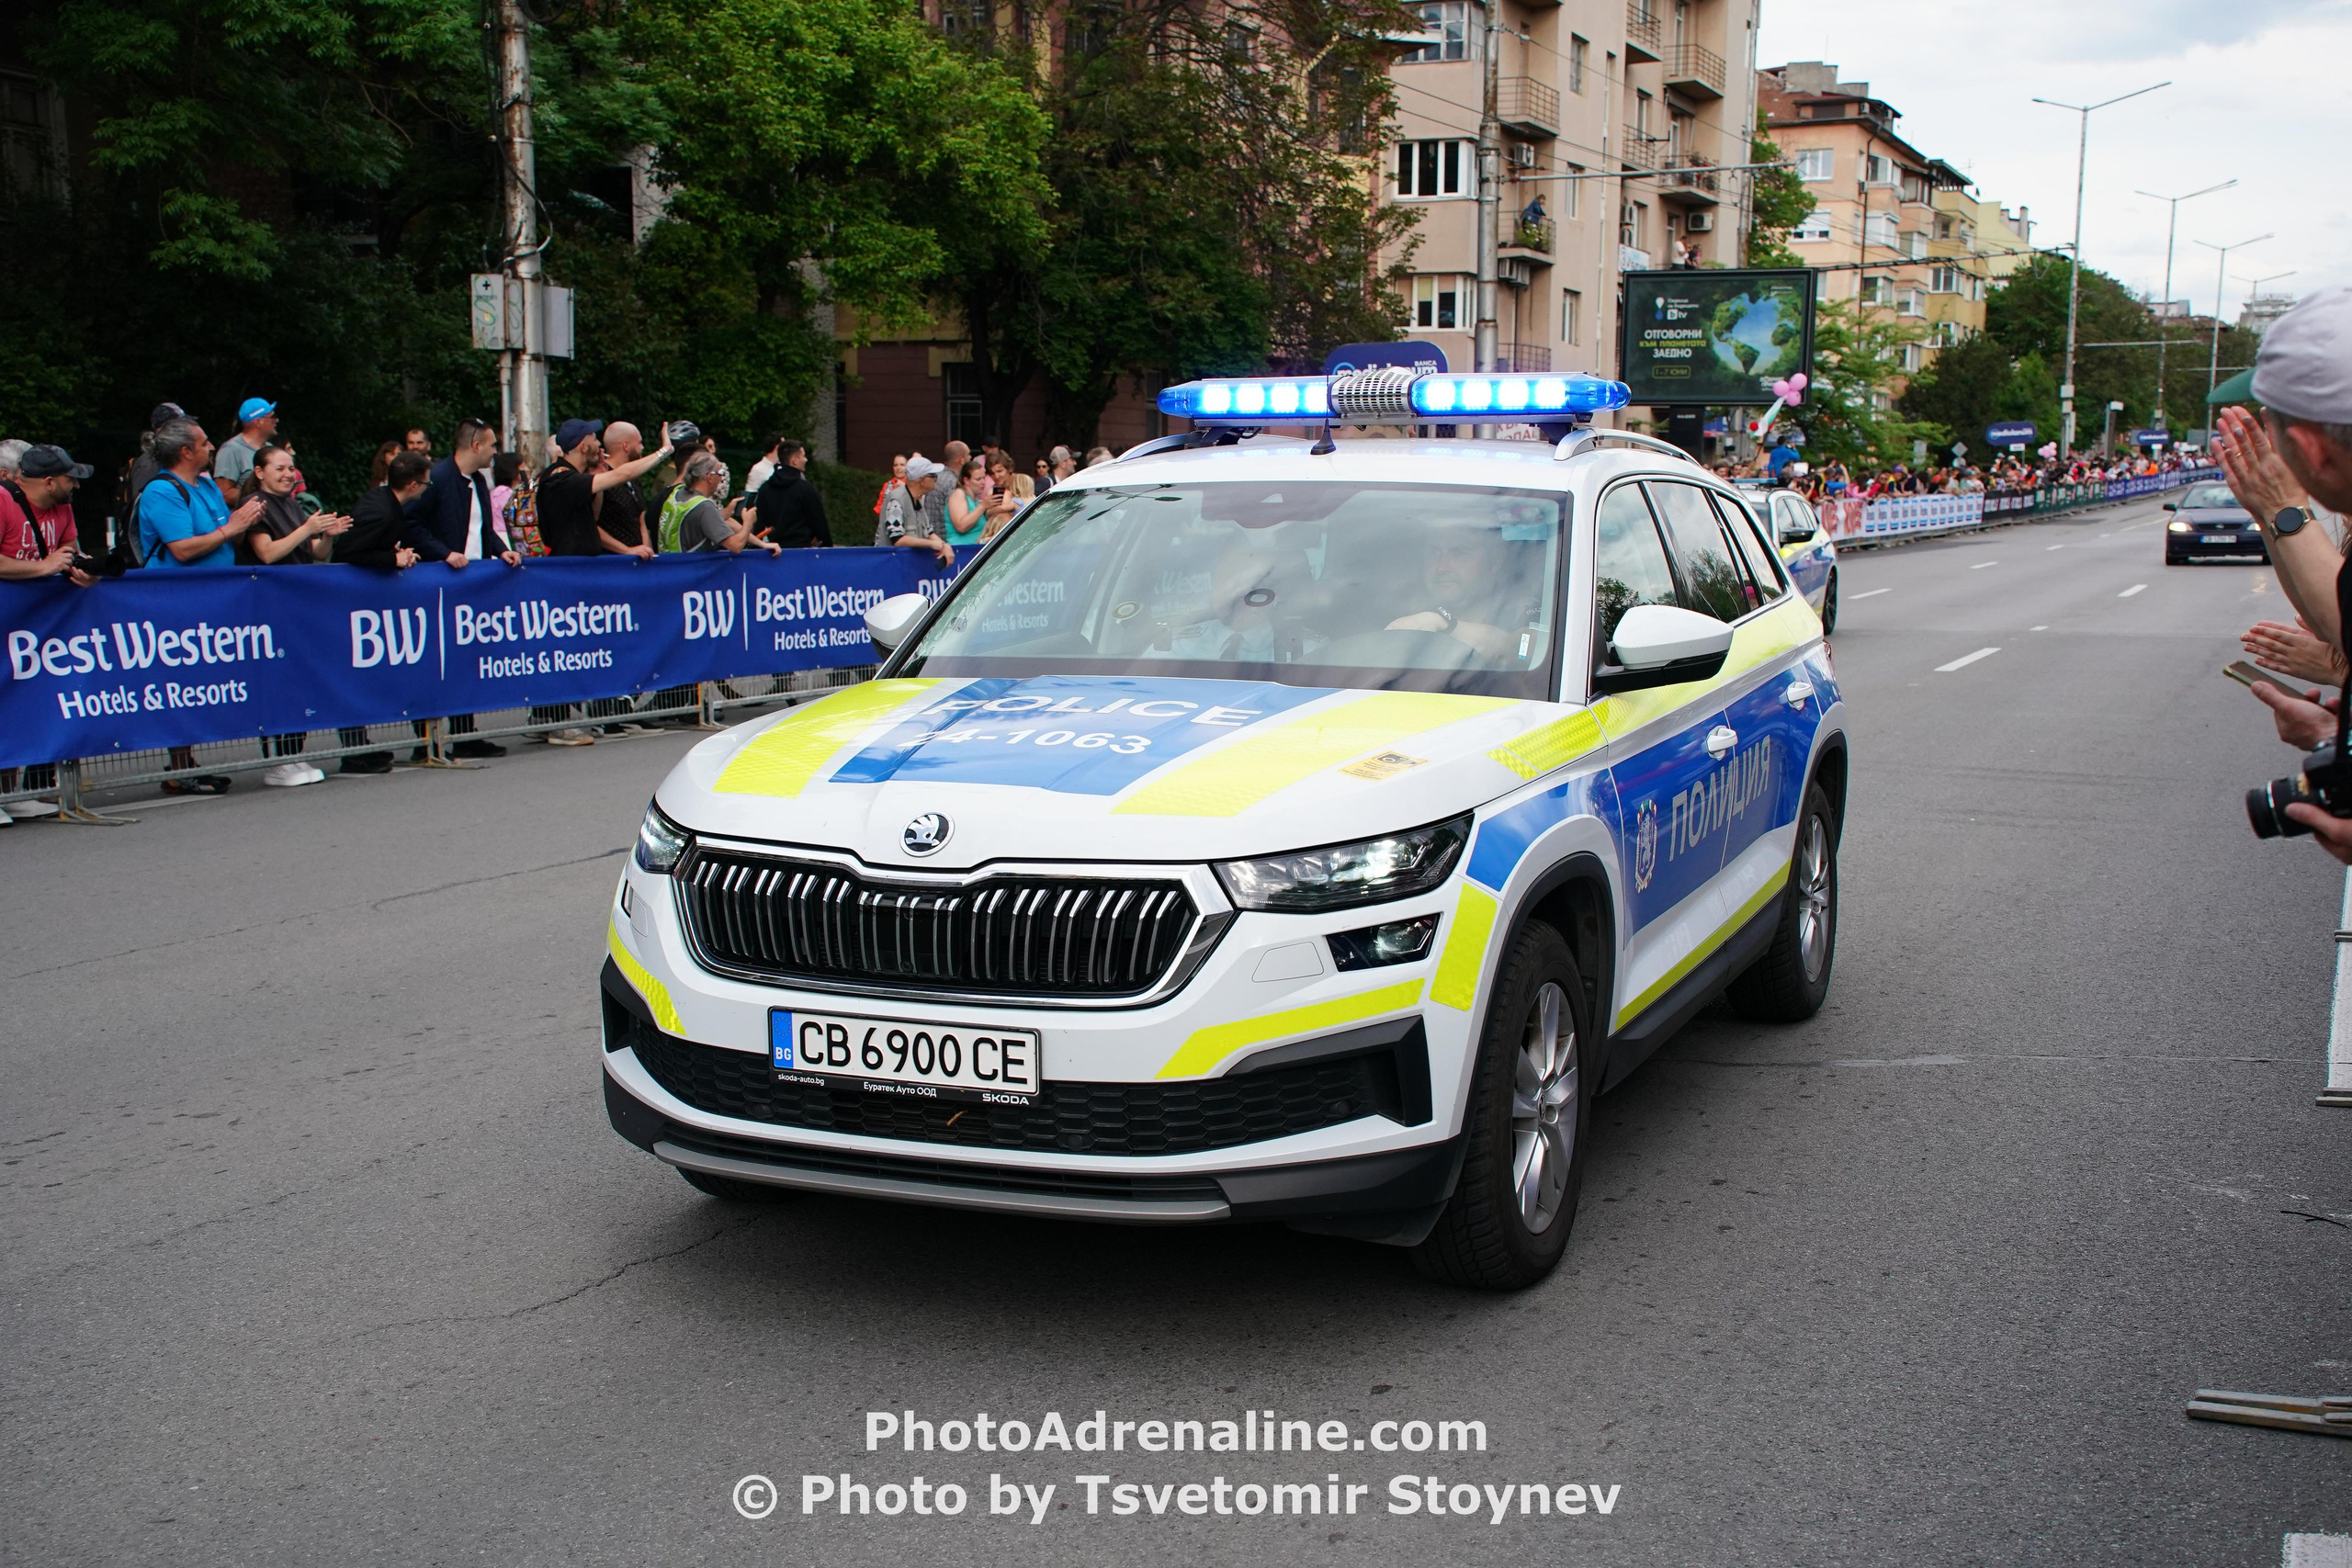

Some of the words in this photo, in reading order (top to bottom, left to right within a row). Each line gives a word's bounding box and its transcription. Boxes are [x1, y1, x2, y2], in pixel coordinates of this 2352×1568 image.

[1644, 329, 1702, 340] ОТГОВОРНИ
[1653, 348, 1692, 358] ЗАЕДНО
[683, 589, 734, 639] BW
[756, 587, 805, 622] Best
[350, 606, 426, 668] BW
[455, 604, 518, 645] Best
[520, 600, 634, 640] Western
[981, 615, 1008, 632] Hotels
[1017, 613, 1049, 629] Resorts
[8, 628, 113, 680] Best
[112, 620, 276, 670] Western
[775, 628, 816, 651] Hotels
[819, 628, 828, 647] &
[829, 627, 872, 646] Resorts
[479, 652, 535, 679] Hotels
[537, 651, 551, 673] &
[554, 648, 613, 671] Resorts
[57, 685, 138, 719] Hotels
[143, 683, 164, 711] &
[165, 680, 248, 708] Resorts
[920, 695, 1263, 727] POLICE
[896, 728, 1152, 755] 24-1063
[1669, 734, 1770, 863] ПОЛИЦИЯ
[775, 1047, 792, 1061] BG
[799, 1021, 851, 1067] CB
[861, 1027, 962, 1077] 6900
[972, 1036, 1028, 1085] CE
[778, 1074, 825, 1087] skoda-auto.bg
[864, 1081, 895, 1095] Еуратек
[896, 1085, 917, 1097] Ауто
[917, 1086, 937, 1098] ООД
